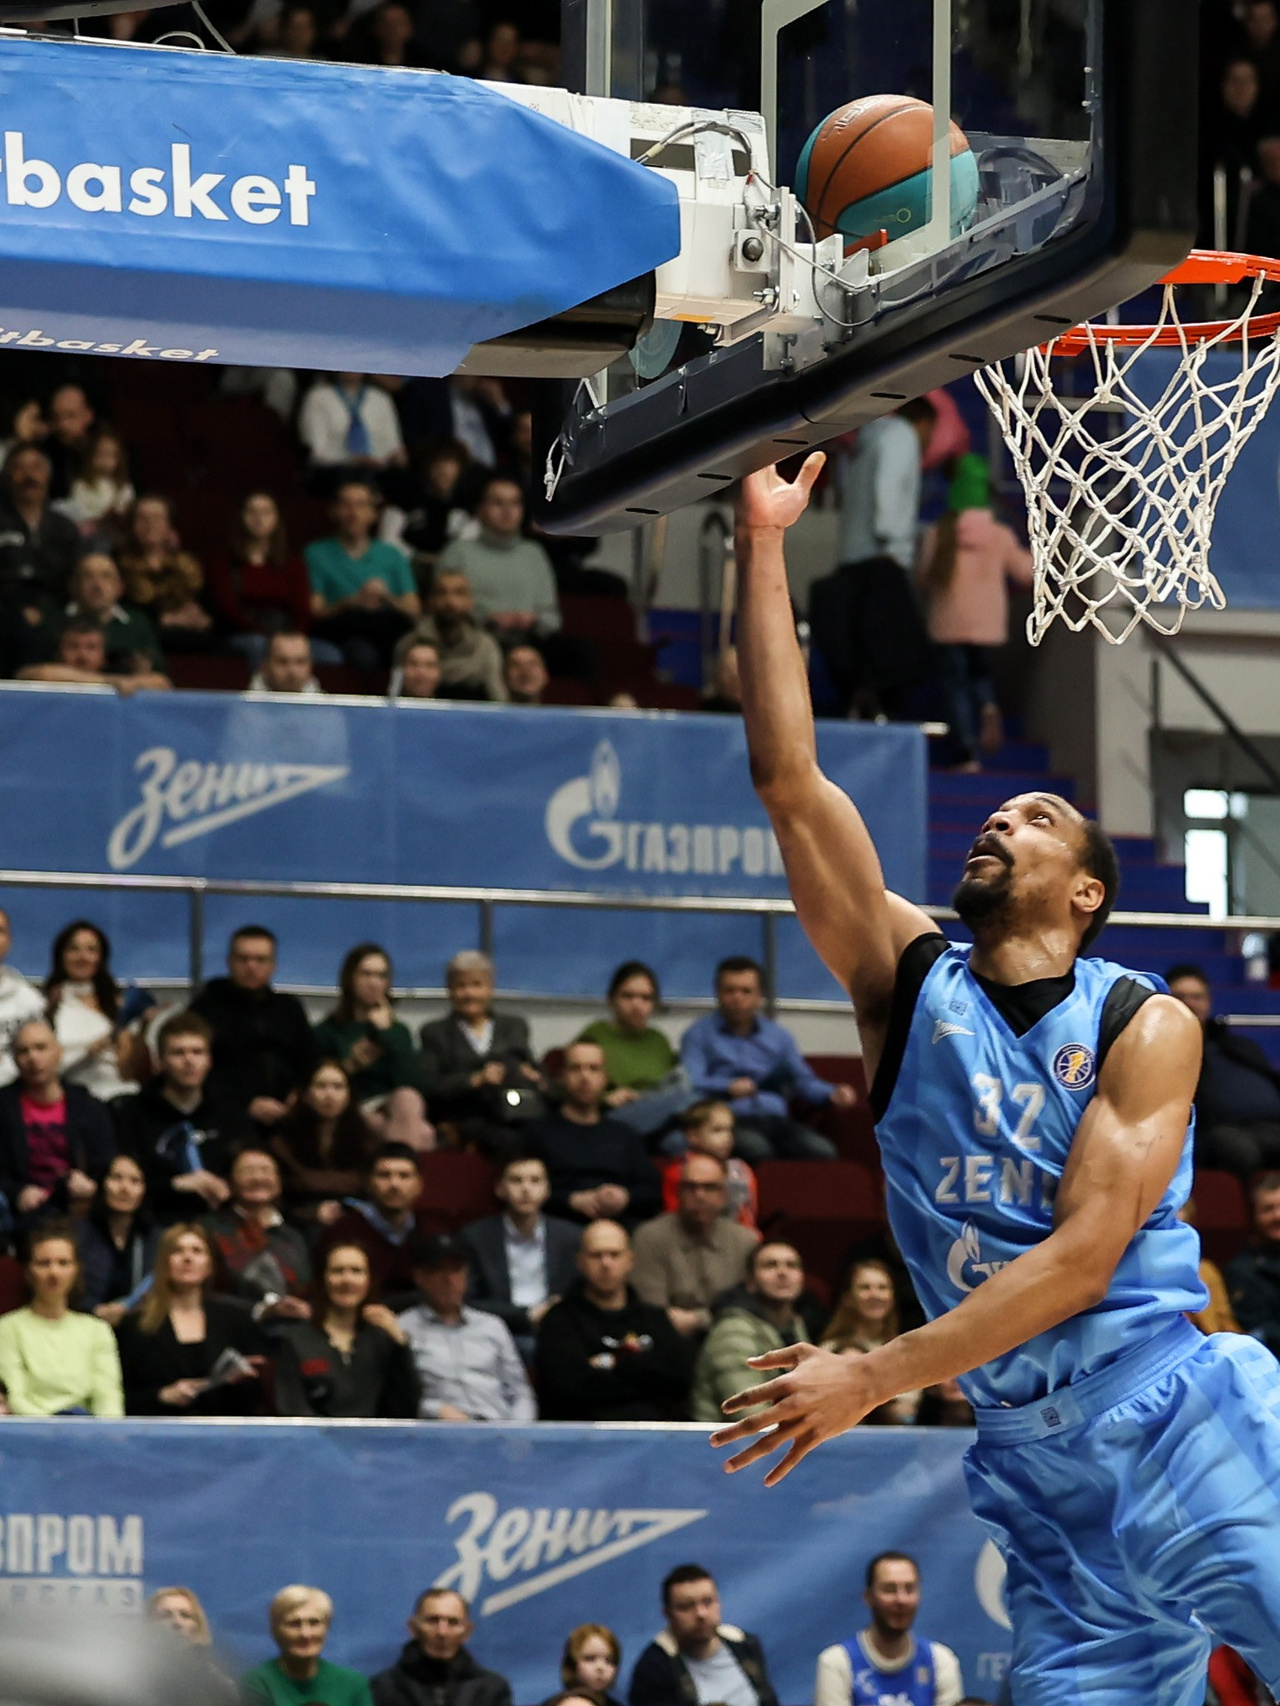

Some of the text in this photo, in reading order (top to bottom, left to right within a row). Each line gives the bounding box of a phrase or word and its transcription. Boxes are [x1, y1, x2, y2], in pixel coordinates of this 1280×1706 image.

[0, 130, 317, 227] basket
[0, 328, 220, 361] tbasket
[973, 1071, 1046, 1150] 32
[0, 1513, 144, 1575] ПРОМ
